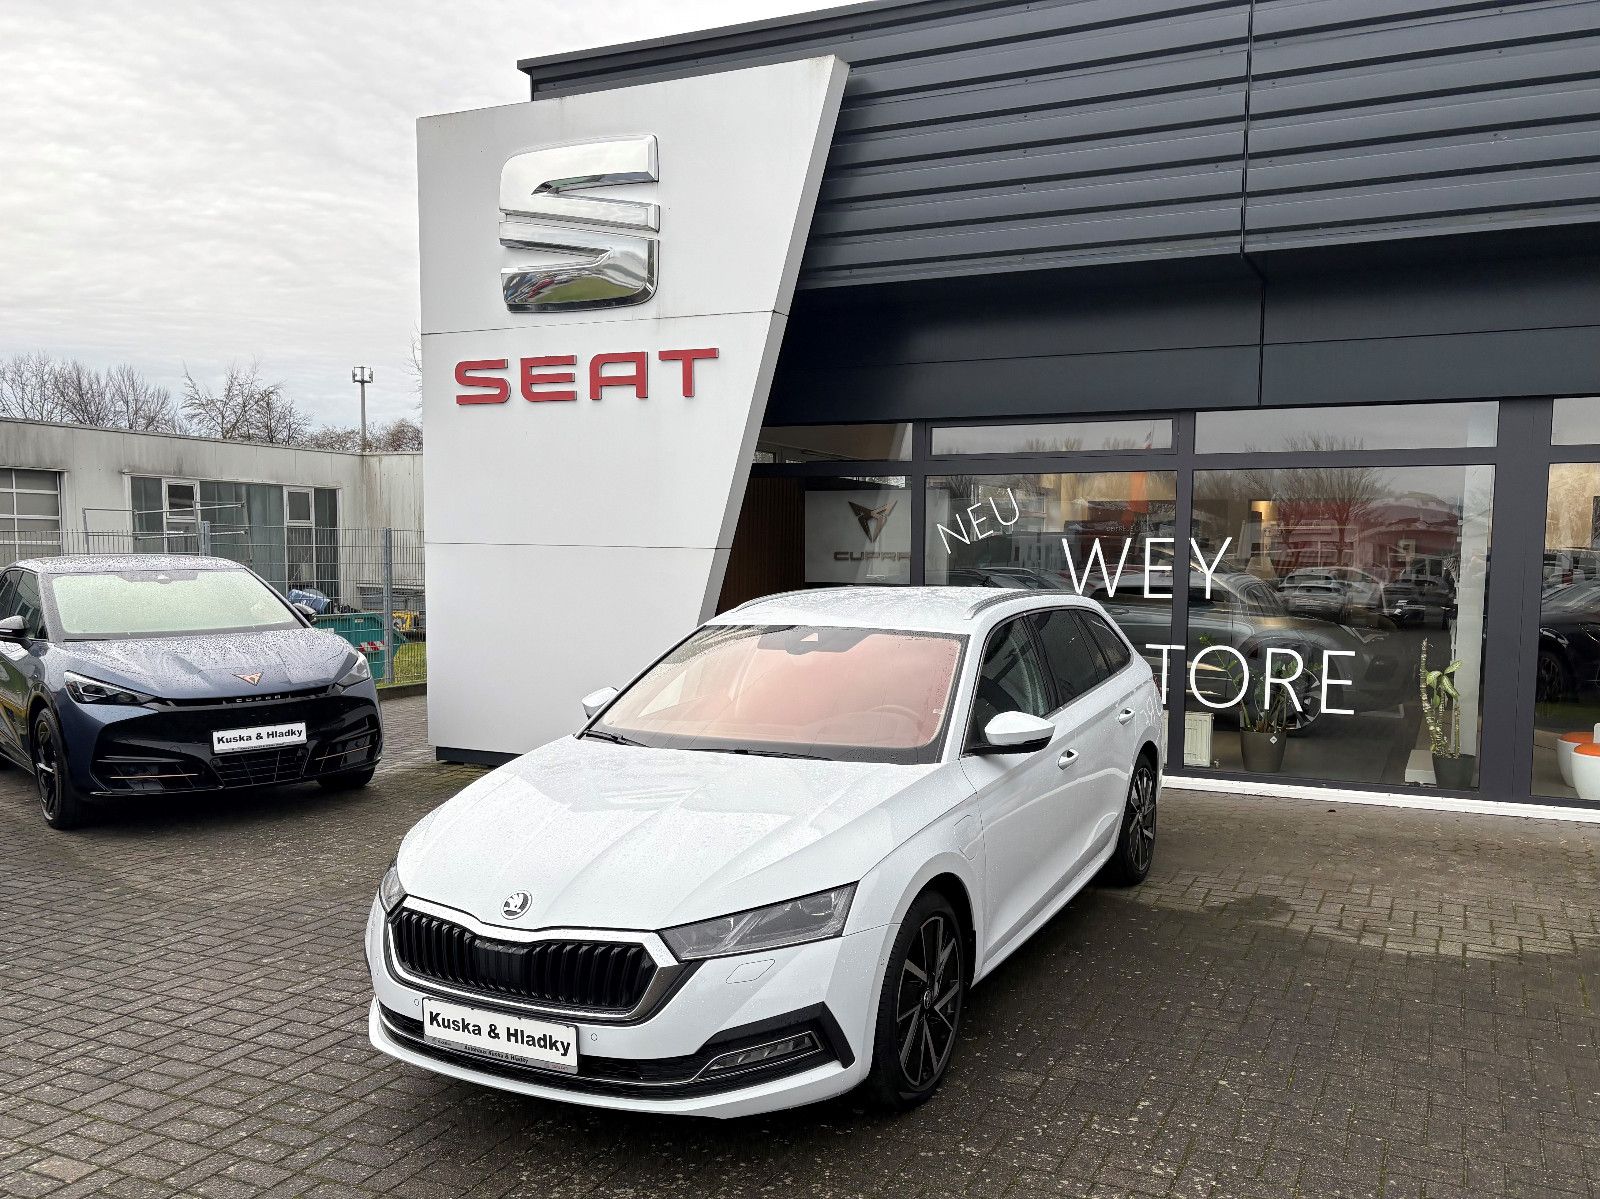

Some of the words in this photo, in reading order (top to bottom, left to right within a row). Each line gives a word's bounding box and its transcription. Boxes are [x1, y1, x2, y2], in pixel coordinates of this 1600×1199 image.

[455, 348, 719, 405] SEAT
[936, 488, 1020, 554] NEU
[1062, 536, 1233, 600] WEY
[1145, 644, 1356, 715] TORE
[217, 734, 252, 744] Kuska
[255, 732, 264, 740] &
[266, 729, 303, 739] Hladky
[429, 1011, 482, 1036] Kuska
[487, 1023, 501, 1040] &
[506, 1027, 571, 1056] Hladky
